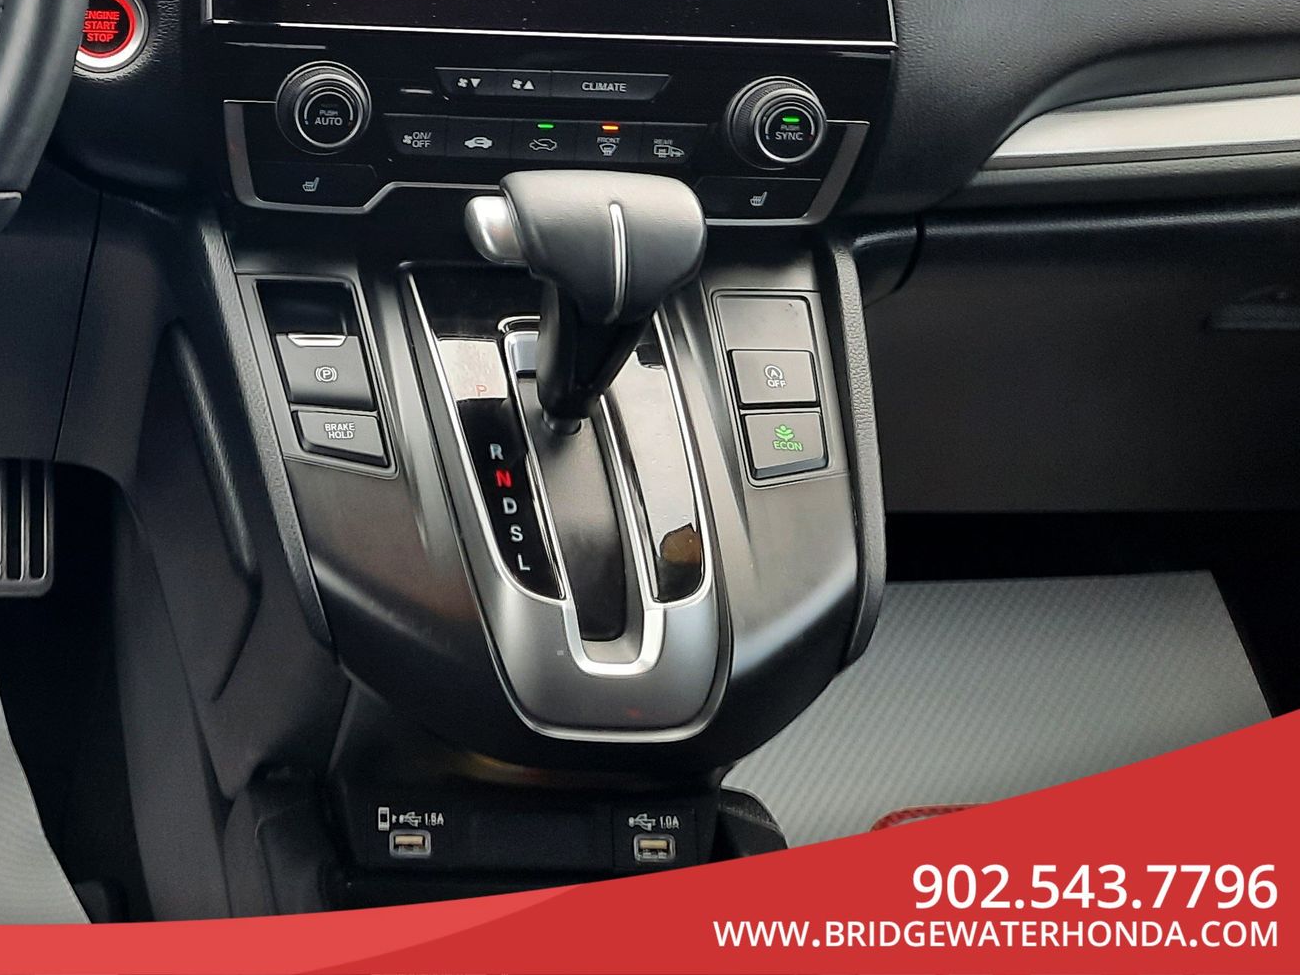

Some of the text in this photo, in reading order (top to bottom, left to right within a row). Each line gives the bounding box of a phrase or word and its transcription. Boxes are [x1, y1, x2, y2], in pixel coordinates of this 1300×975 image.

[84, 20, 117, 30] START
[86, 32, 114, 42] STOP
[581, 81, 627, 93] CLIMATE
[314, 117, 343, 126] AUTO
[597, 136, 621, 144] FRONT
[774, 131, 803, 141] SYNC
[412, 140, 431, 148] OFF
[767, 379, 787, 387] OFF
[324, 423, 355, 431] BRAKE
[328, 431, 353, 439] HOLD
[773, 440, 803, 451] ECON
[490, 443, 504, 460] R
[495, 469, 512, 487] N
[502, 497, 517, 514] D
[510, 525, 523, 542] S
[517, 554, 531, 571] L
